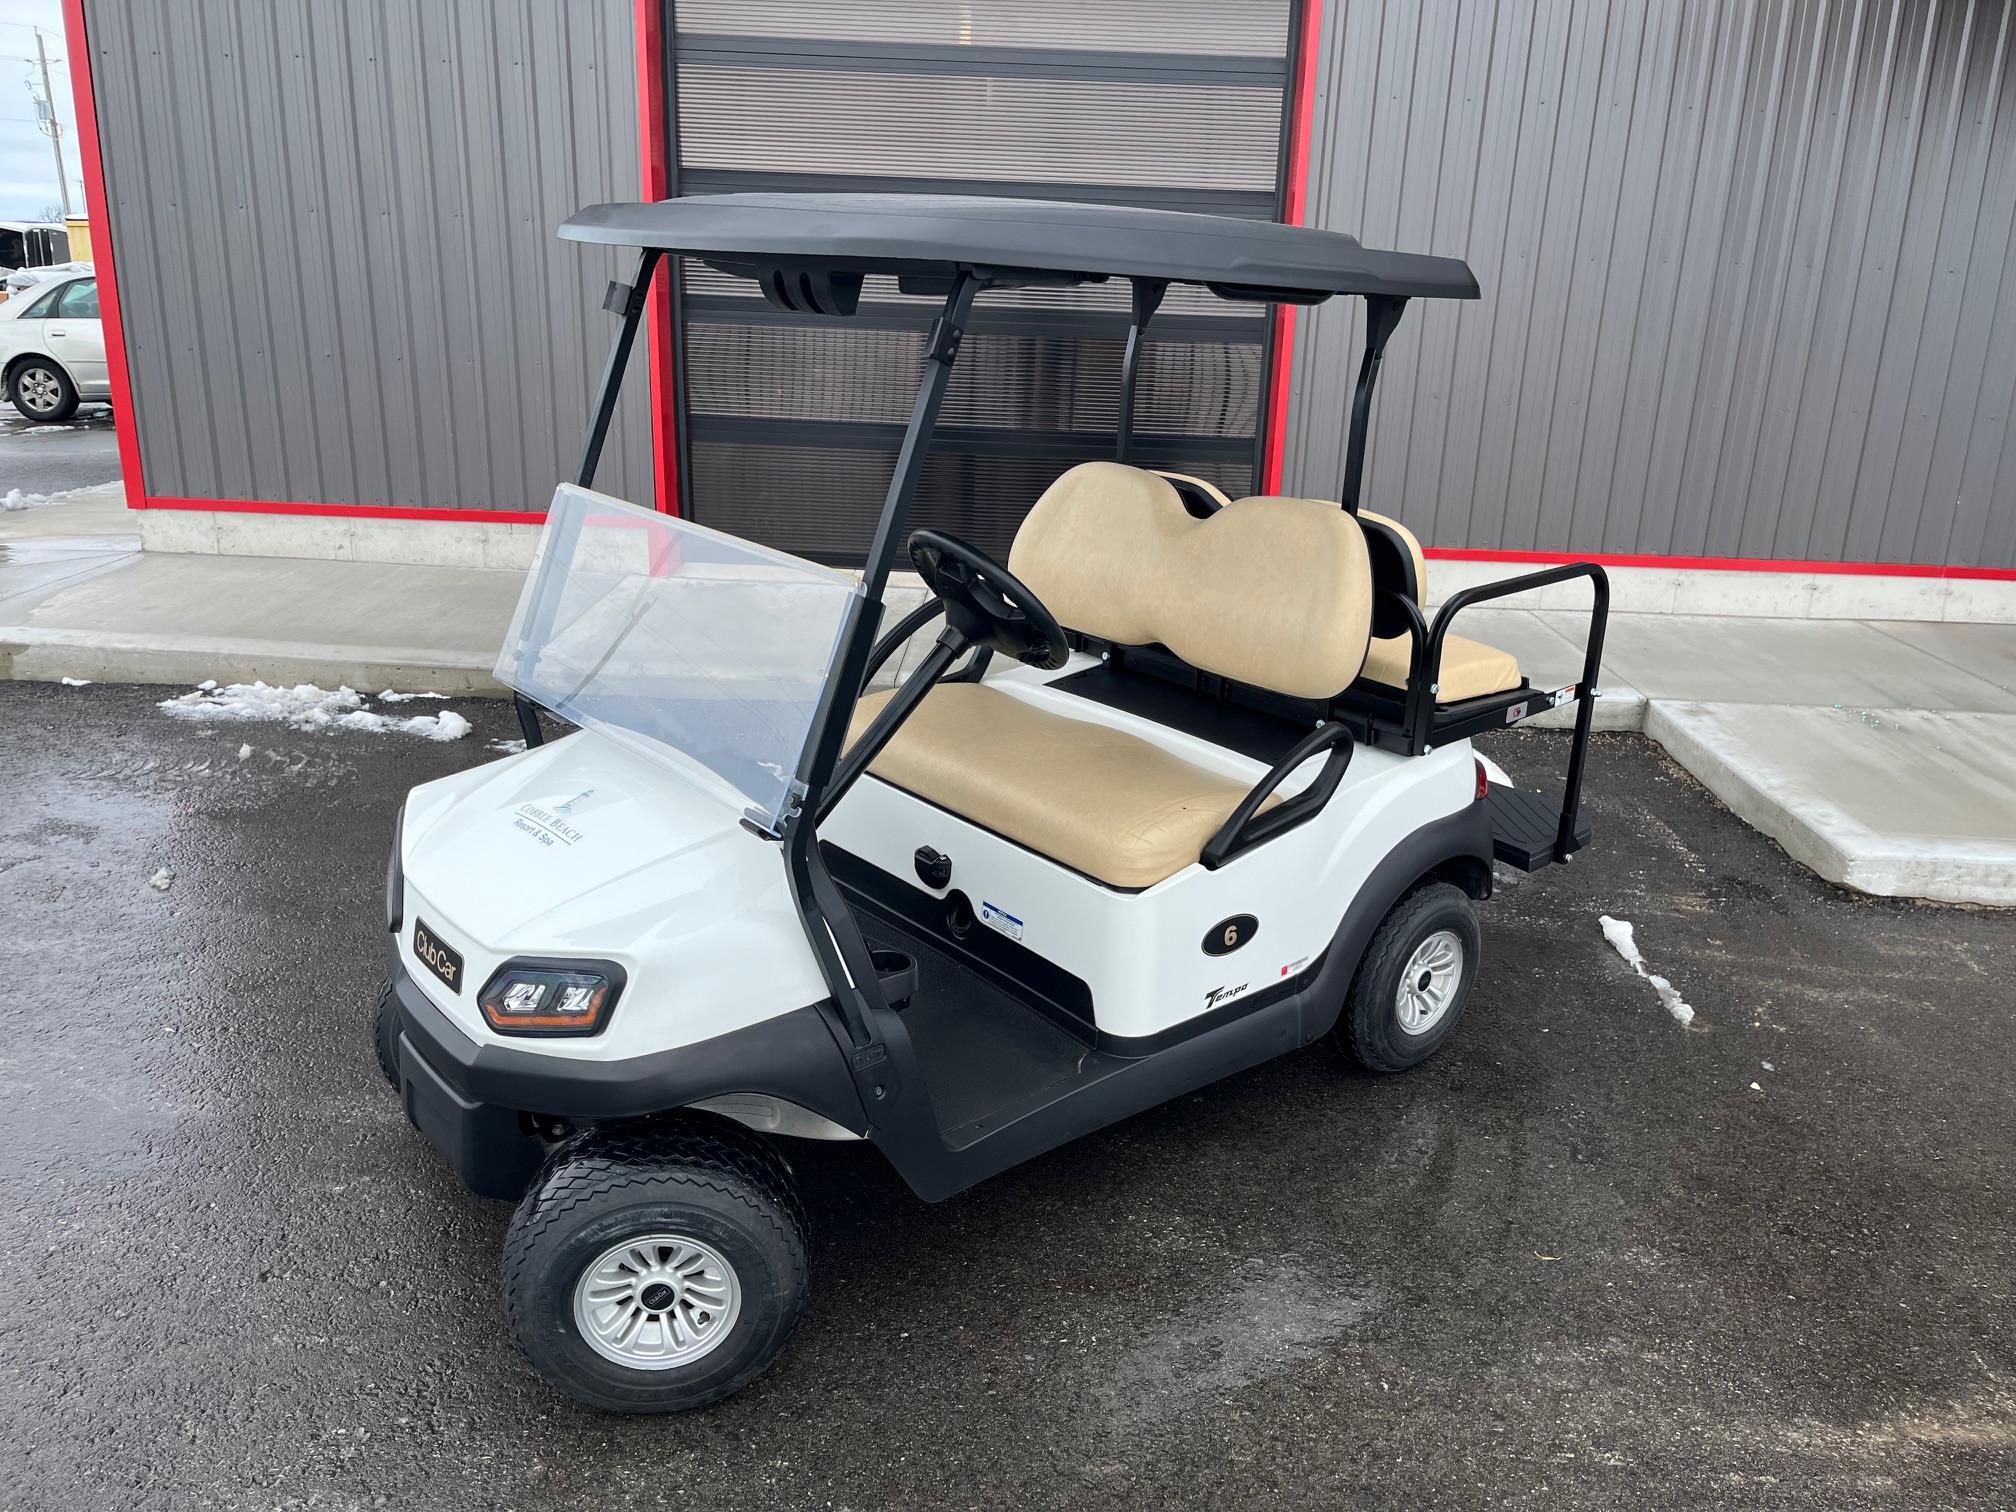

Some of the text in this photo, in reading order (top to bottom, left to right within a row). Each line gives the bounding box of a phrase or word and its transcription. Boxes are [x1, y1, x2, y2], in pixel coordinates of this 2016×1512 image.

[513, 818, 554, 847] Resort & Spa
[520, 803, 583, 843] COBBLE BEACH
[1224, 925, 1238, 946] 6
[417, 930, 456, 981] Club Car
[1204, 982, 1250, 1009] Tempo
